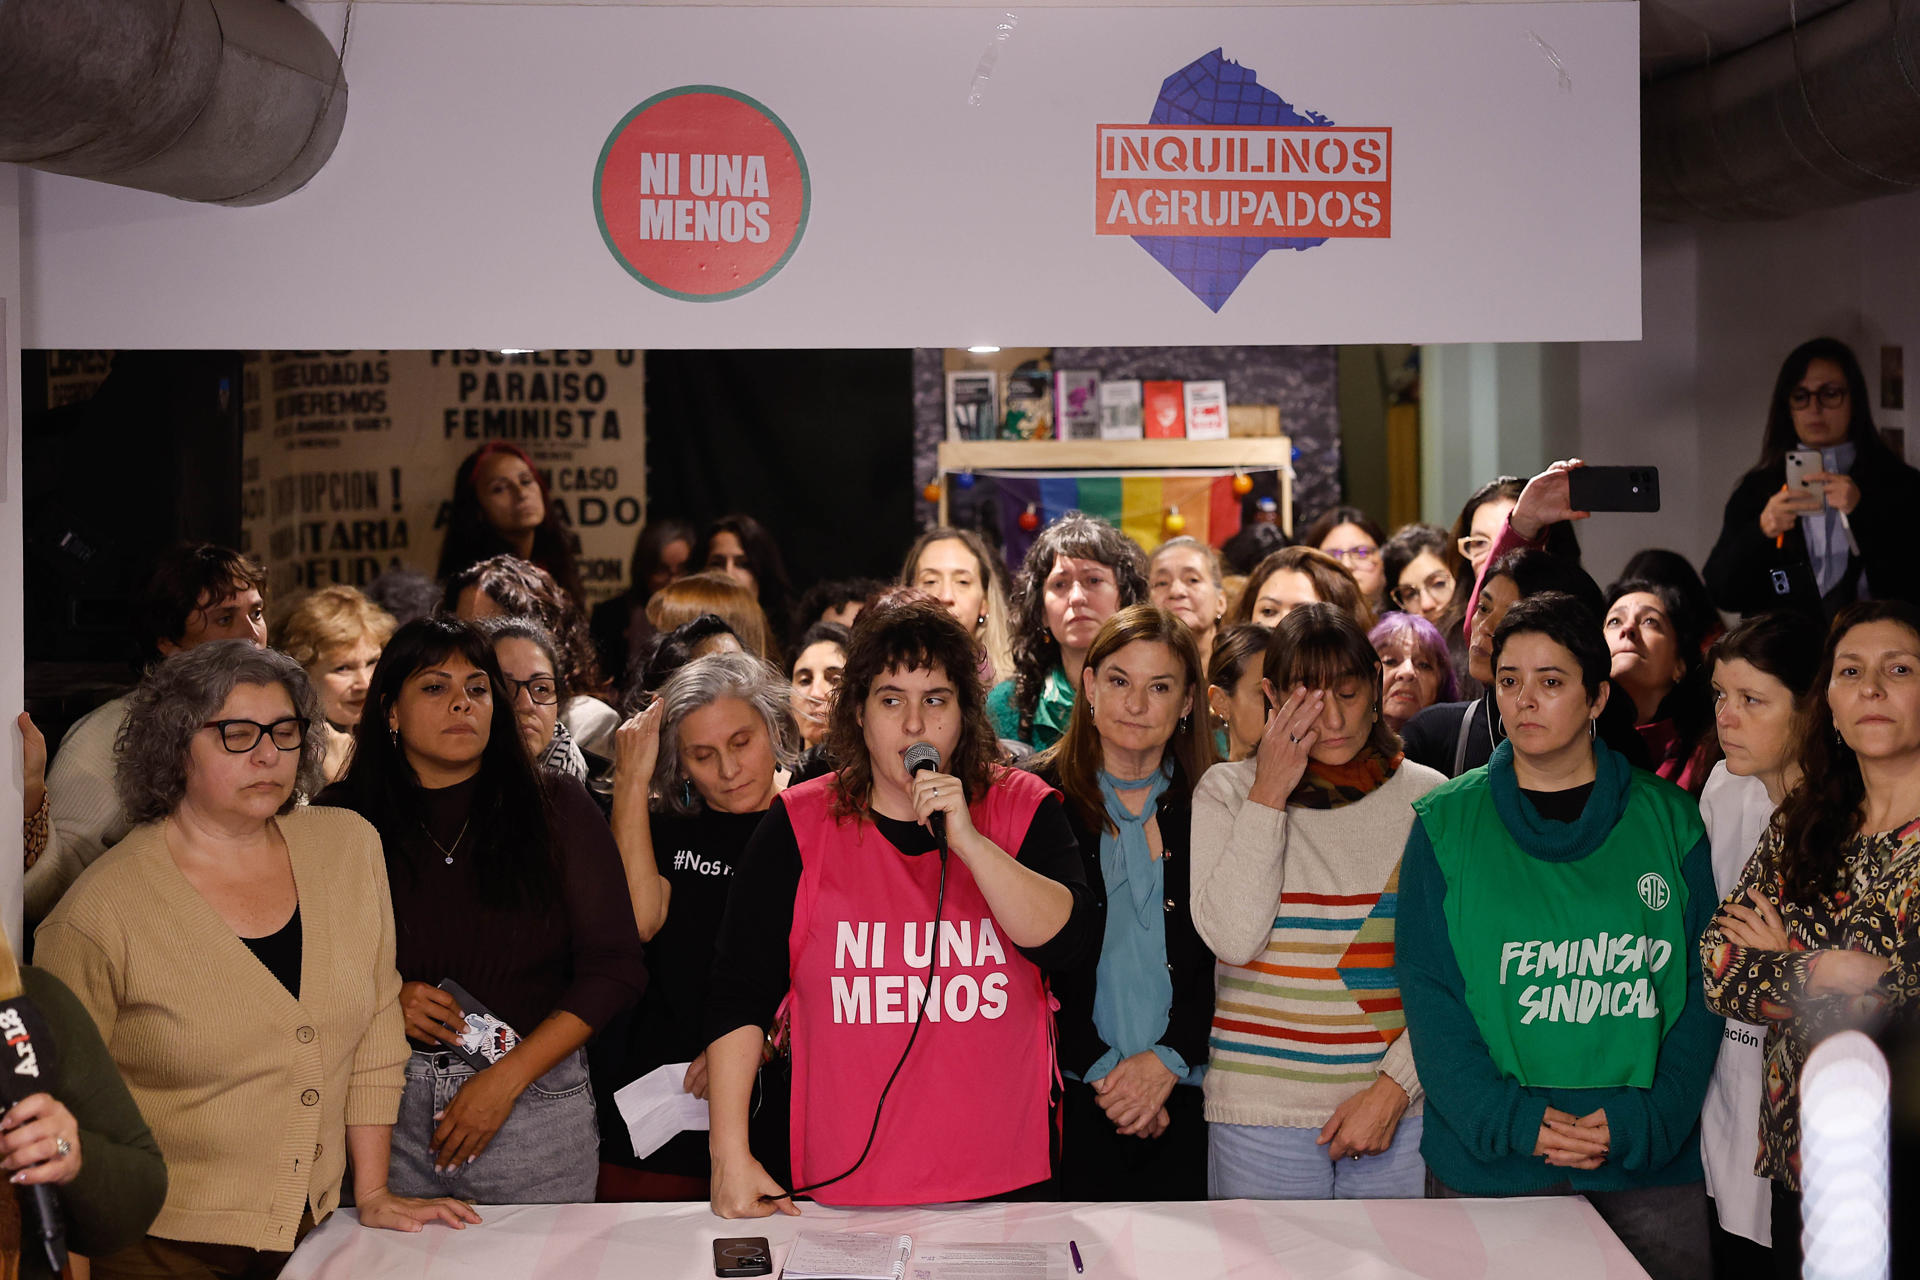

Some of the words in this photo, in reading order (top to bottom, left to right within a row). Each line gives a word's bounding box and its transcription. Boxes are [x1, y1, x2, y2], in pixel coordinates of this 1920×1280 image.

[640, 152, 680, 195] NI
[690, 154, 770, 198] UNA
[1106, 136, 1382, 175] INQUILINOS
[639, 198, 771, 243] MENOS
[1105, 189, 1382, 229] AGRUPADOS
[460, 371, 607, 402] PARAISO
[445, 409, 621, 440] FEMINISTA
[559, 466, 619, 491] CASO
[1640, 875, 1666, 908] ATE
[835, 921, 886, 969] NI
[903, 917, 1007, 969] UNA
[1499, 932, 1673, 984] FEMINISMO
[830, 972, 1009, 1024] MENOS
[1518, 978, 1660, 1024] SINDICAL
